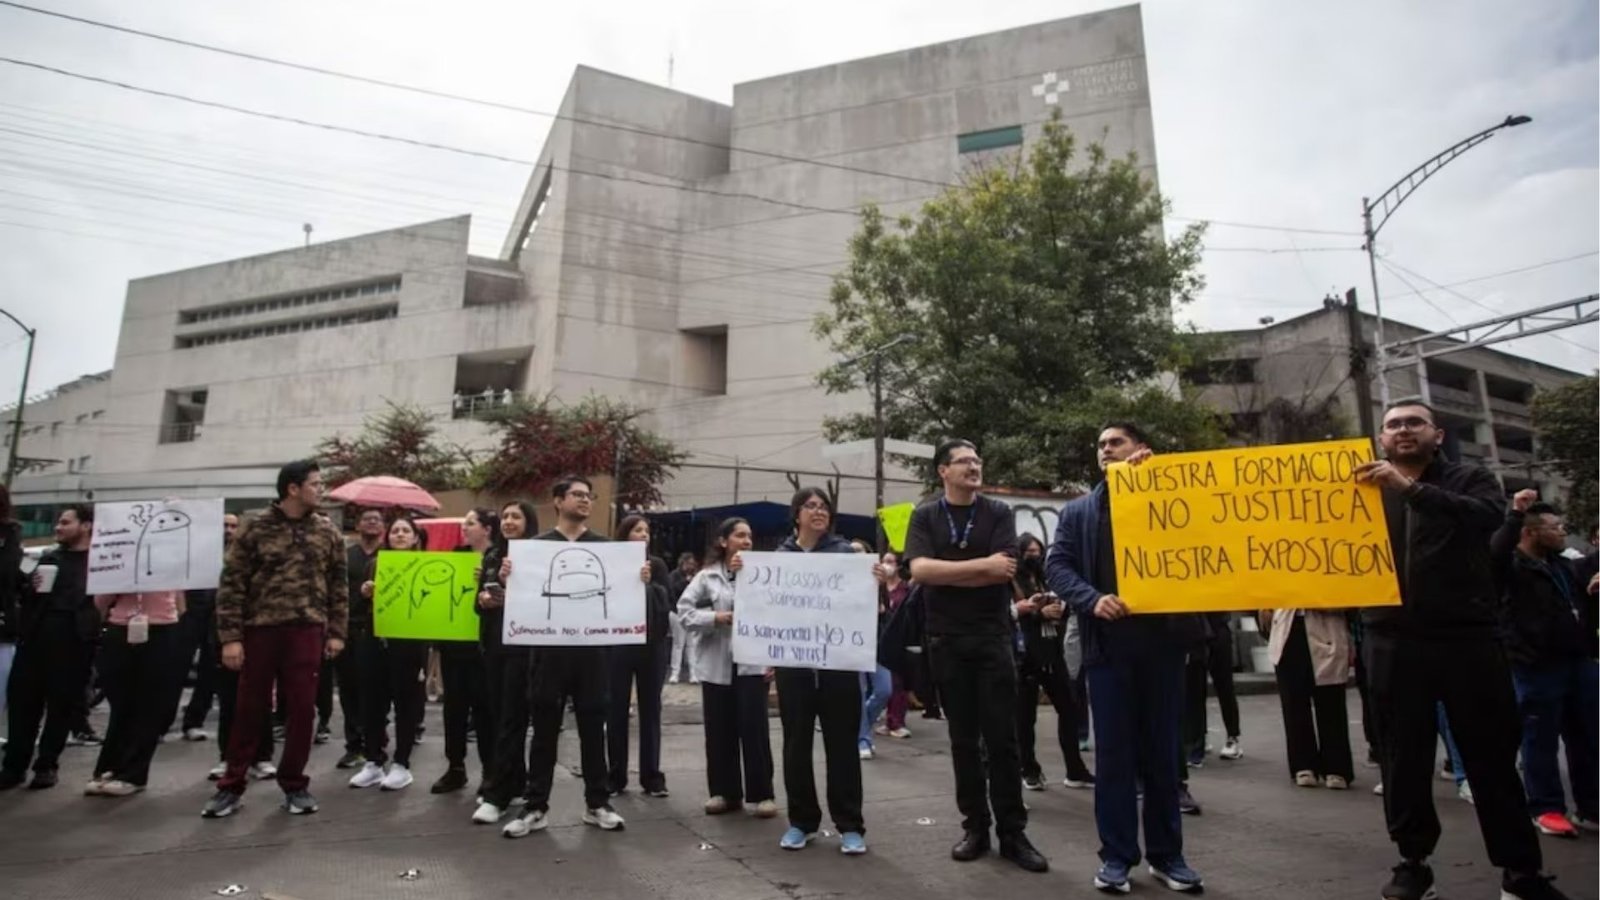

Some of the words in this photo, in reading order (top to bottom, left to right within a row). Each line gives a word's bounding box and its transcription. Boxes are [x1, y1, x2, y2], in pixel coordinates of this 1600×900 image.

[1115, 460, 1218, 495] NUESTRA
[1148, 498, 1191, 531] NO
[1211, 488, 1373, 524] JUSTIFICA
[1123, 545, 1234, 581] NUESTRA
[1247, 531, 1395, 576] EXPOSICIÓN
[768, 644, 785, 660] un
[815, 623, 844, 646] NO
[851, 630, 864, 646] es
